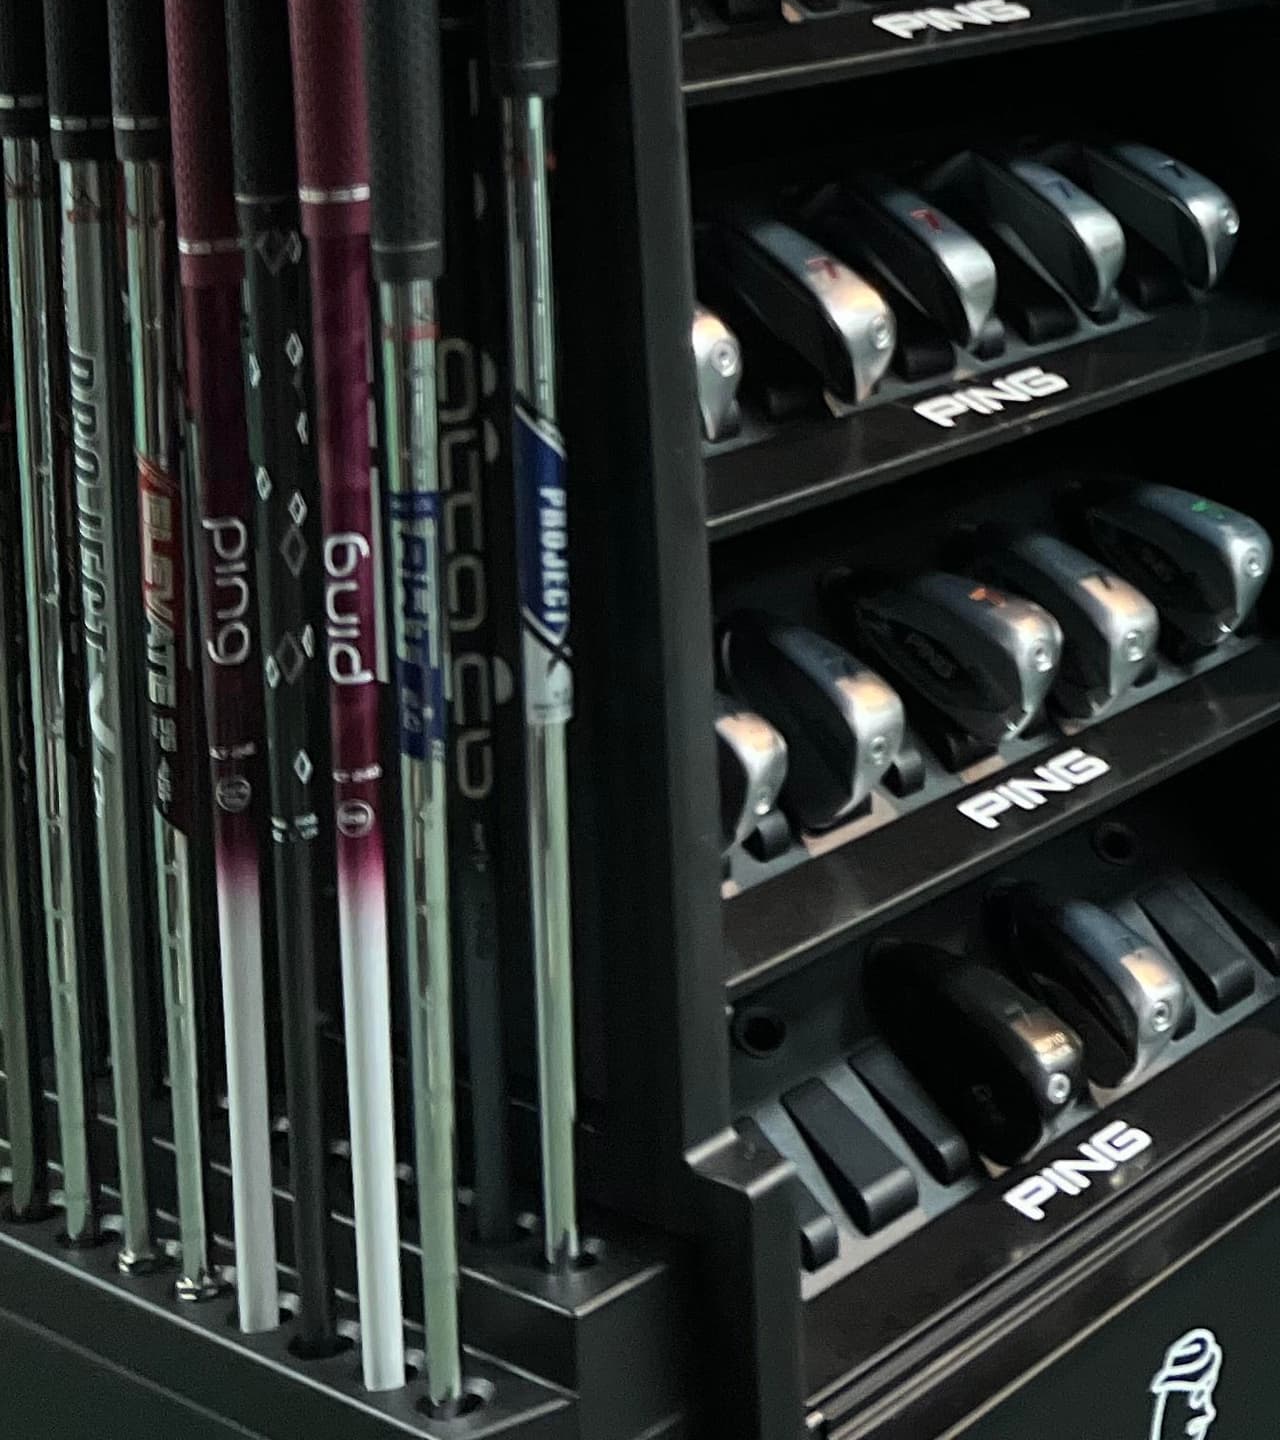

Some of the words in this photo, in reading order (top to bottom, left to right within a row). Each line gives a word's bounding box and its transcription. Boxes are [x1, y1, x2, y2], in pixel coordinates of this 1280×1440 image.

[912, 365, 1069, 428] PING
[143, 492, 177, 709] ELEVATE
[202, 515, 250, 665] ping
[323, 531, 375, 685] ping
[538, 486, 570, 626] PROJECT
[955, 747, 1111, 830] PING
[1002, 1119, 1154, 1222] PING
